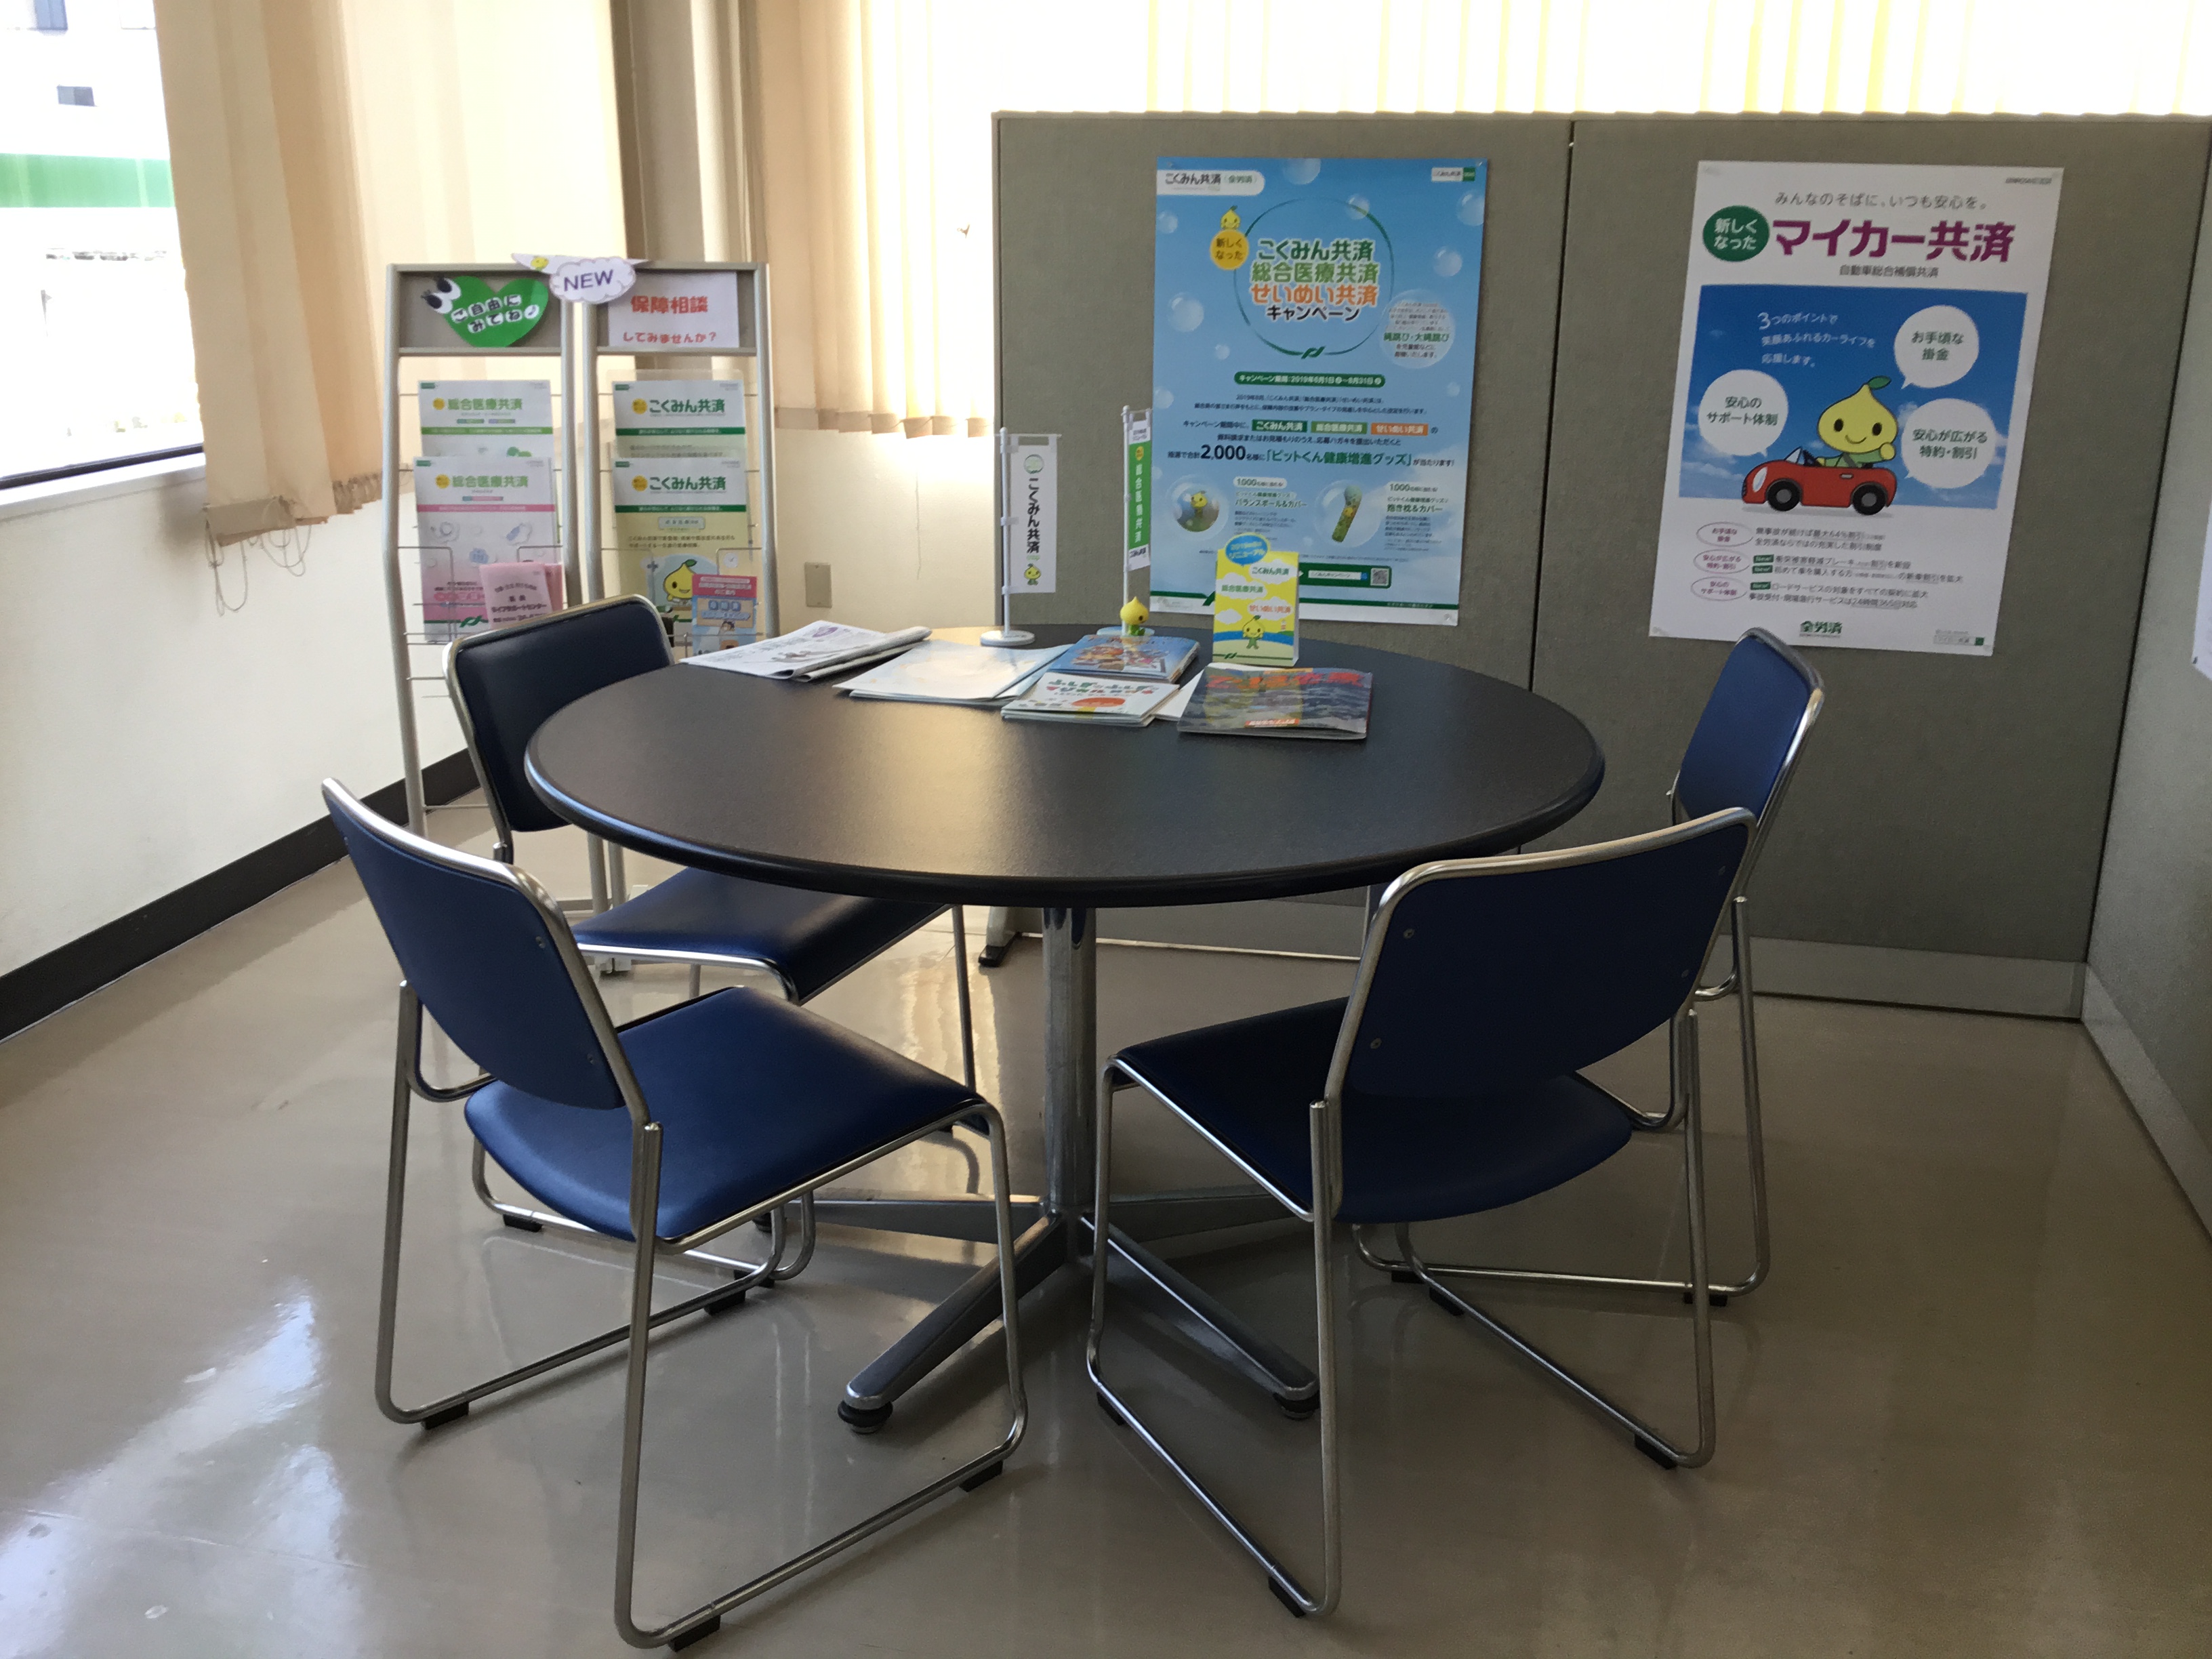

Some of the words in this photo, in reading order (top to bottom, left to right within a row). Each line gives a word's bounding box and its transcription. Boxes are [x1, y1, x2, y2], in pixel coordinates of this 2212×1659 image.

[1775, 192, 1987, 210] みんなのそばに、いつも安心を。
[1715, 218, 1758, 232] 新しく
[1216, 237, 1242, 248] 新しく
[1714, 234, 1757, 251] なった
[1772, 219, 2016, 262] マイカー共済
[1215, 250, 1243, 260] なった
[1258, 240, 1374, 261] こくみん共済
[1252, 262, 1378, 283] 総合医療共済
[564, 269, 613, 291] NEW
[1251, 283, 1378, 306] せいめい共済
[630, 295, 708, 314] 保障相談
[1267, 305, 1360, 321] キャンペーン
[1757, 312, 1838, 330] 3つのポイントで
[623, 331, 716, 344] してみませんか?
[1911, 331, 1964, 344] お手頃な
[1762, 353, 1816, 367] 応援します。
[1922, 348, 1949, 361] 掛金
[649, 398, 724, 413] こくみん共済
[1725, 396, 1762, 408] 安心の
[1256, 421, 1303, 431] こくみん共済
[1706, 412, 1779, 426] サポート体制
[1912, 429, 1988, 444] 安心が広がる
[1919, 445, 1977, 459] 特約・割引
[649, 476, 726, 490] こくみん共済
[1027, 478, 1040, 553] こくみん共済
[1252, 567, 1289, 575] こくみん共済
